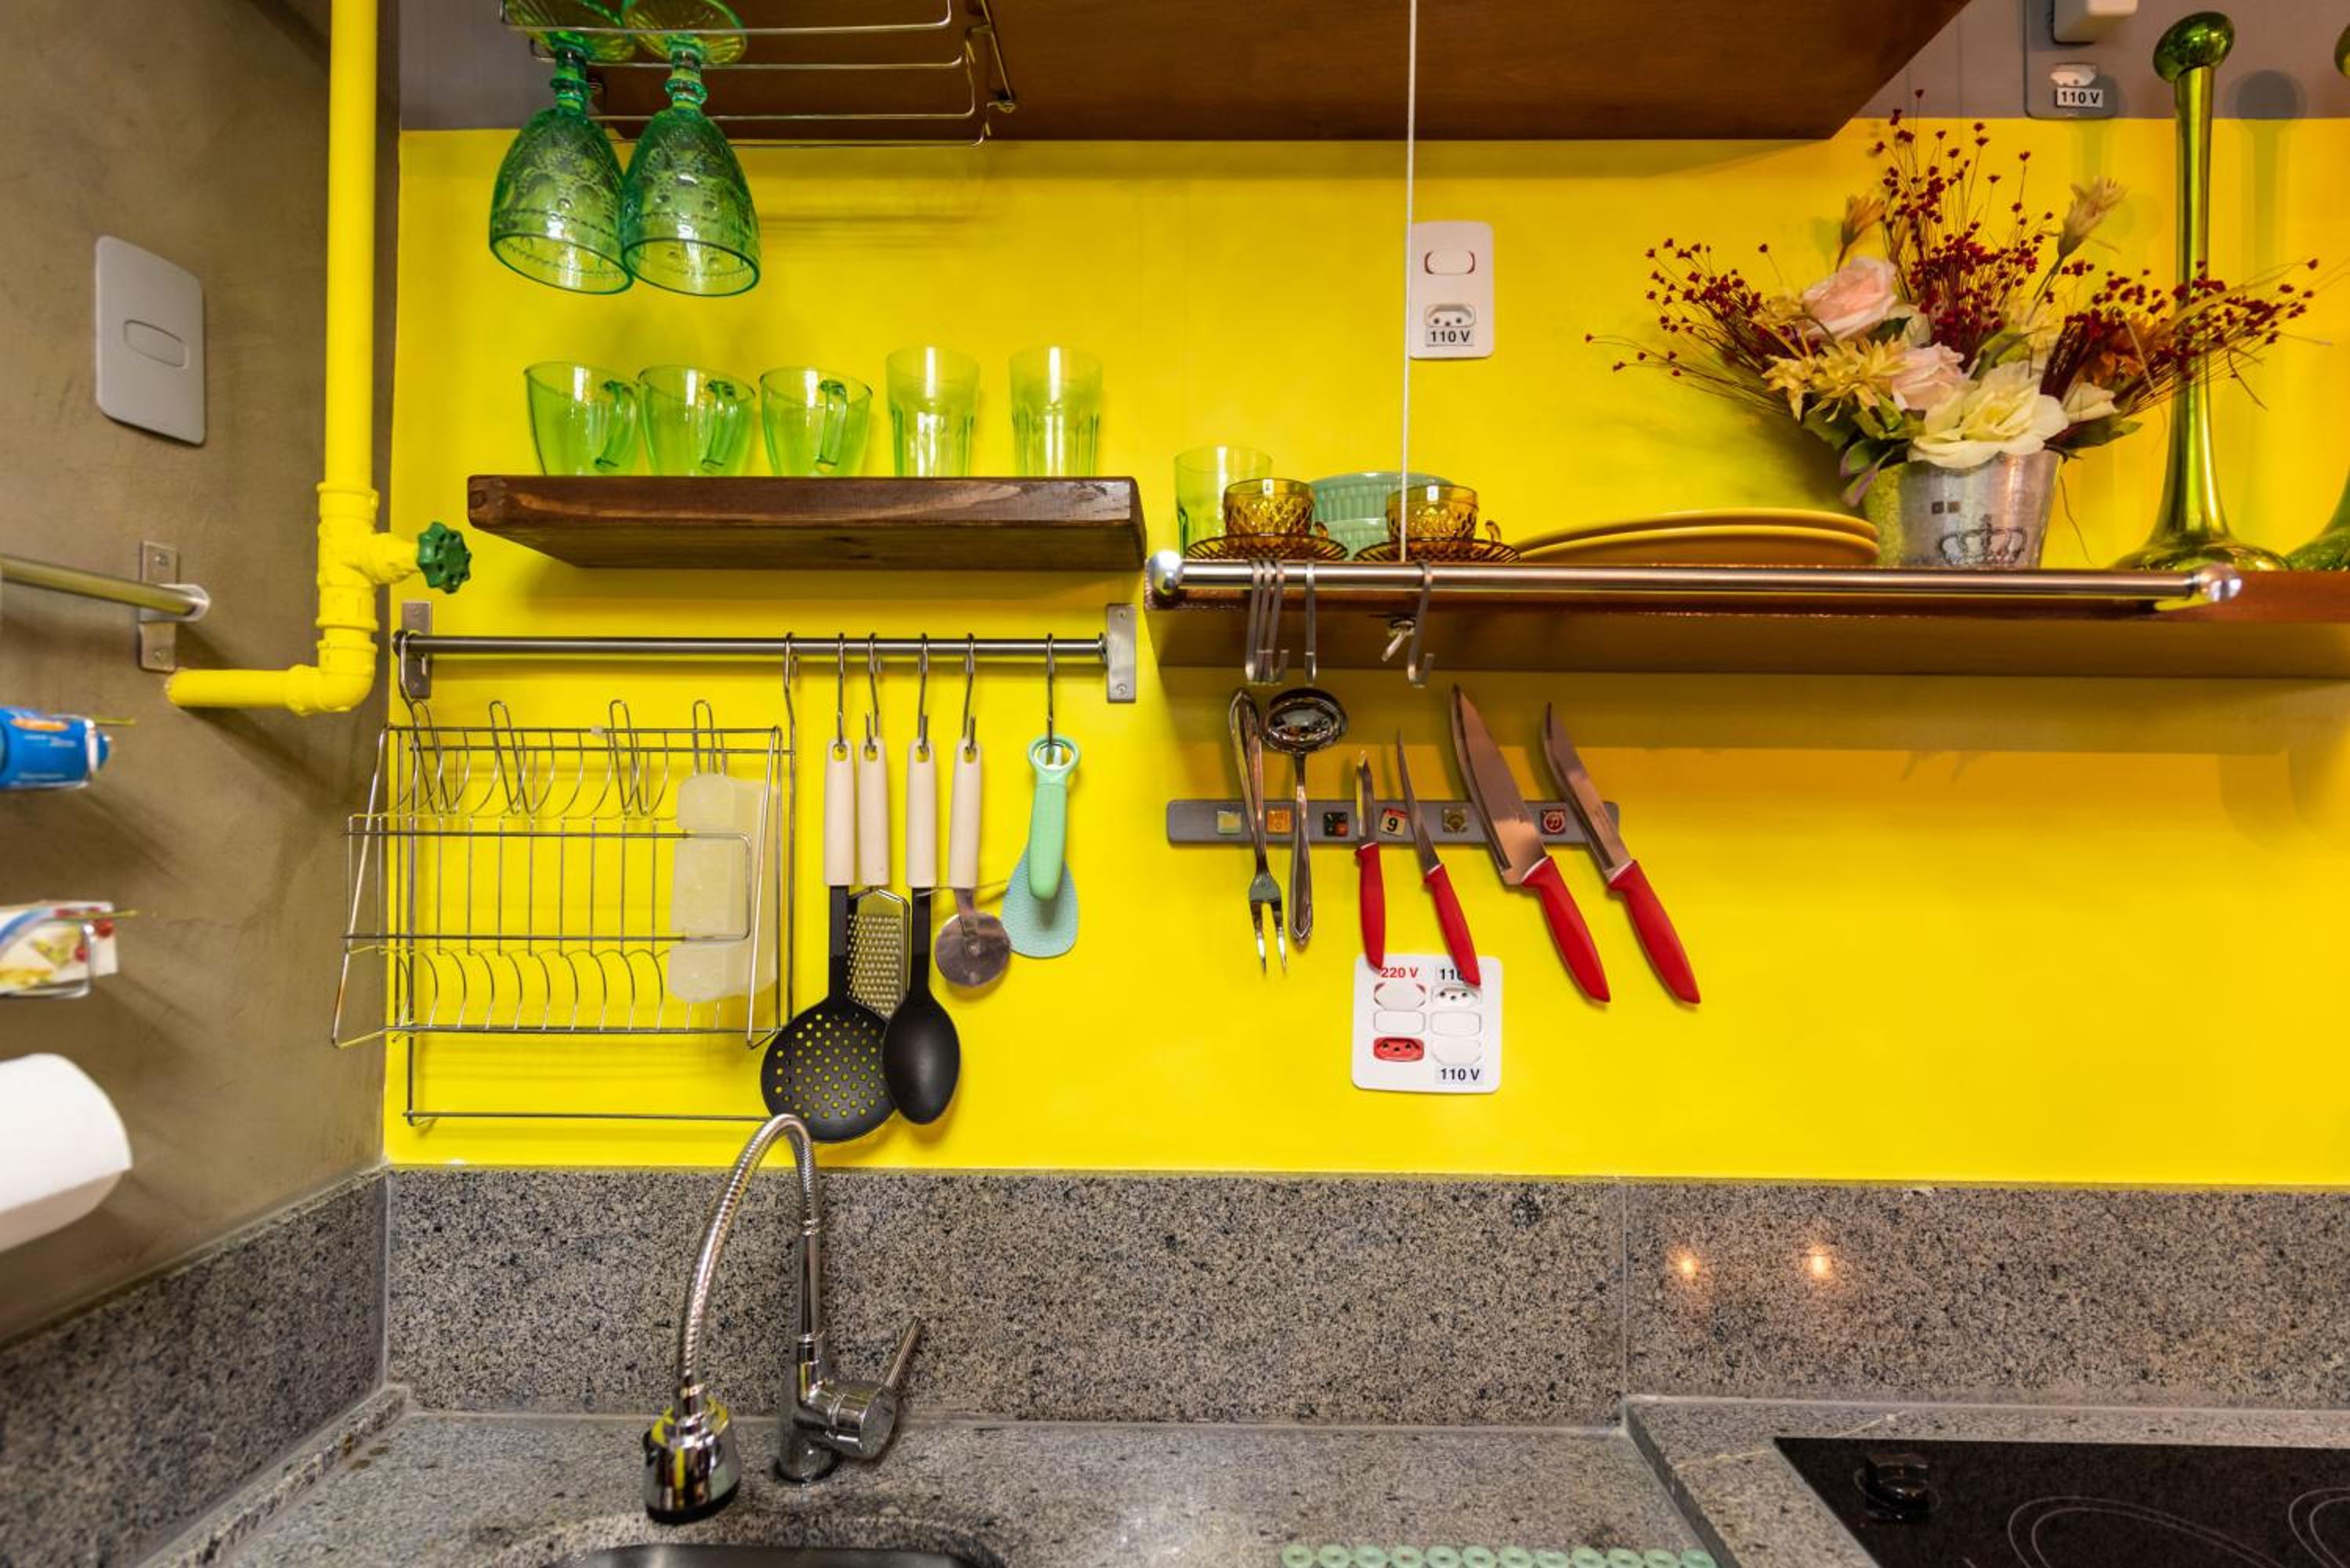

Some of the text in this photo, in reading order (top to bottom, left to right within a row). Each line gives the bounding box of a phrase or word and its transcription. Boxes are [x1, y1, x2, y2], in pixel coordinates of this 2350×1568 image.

[2061, 91, 2100, 104] 110 V
[1430, 330, 1471, 342] 110 V
[1386, 817, 1399, 832] 9
[1381, 966, 1419, 978] 220 V
[1441, 1068, 1480, 1081] 110 V
